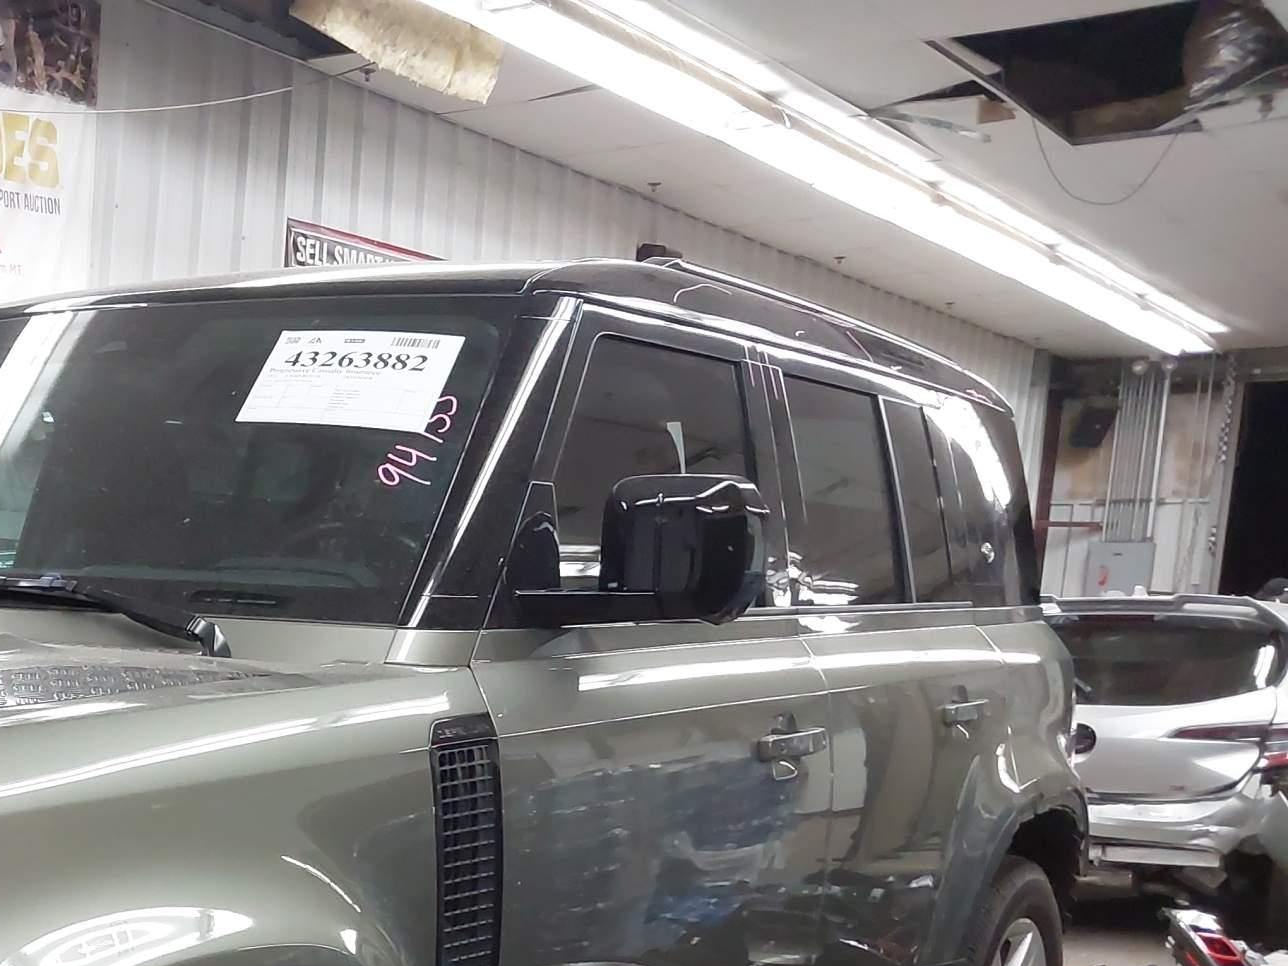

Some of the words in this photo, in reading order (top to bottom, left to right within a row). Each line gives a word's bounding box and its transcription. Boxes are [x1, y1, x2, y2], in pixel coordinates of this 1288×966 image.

[23, 193, 61, 215] AUCTION
[296, 236, 329, 265] SELL
[283, 350, 429, 372] 43263882
